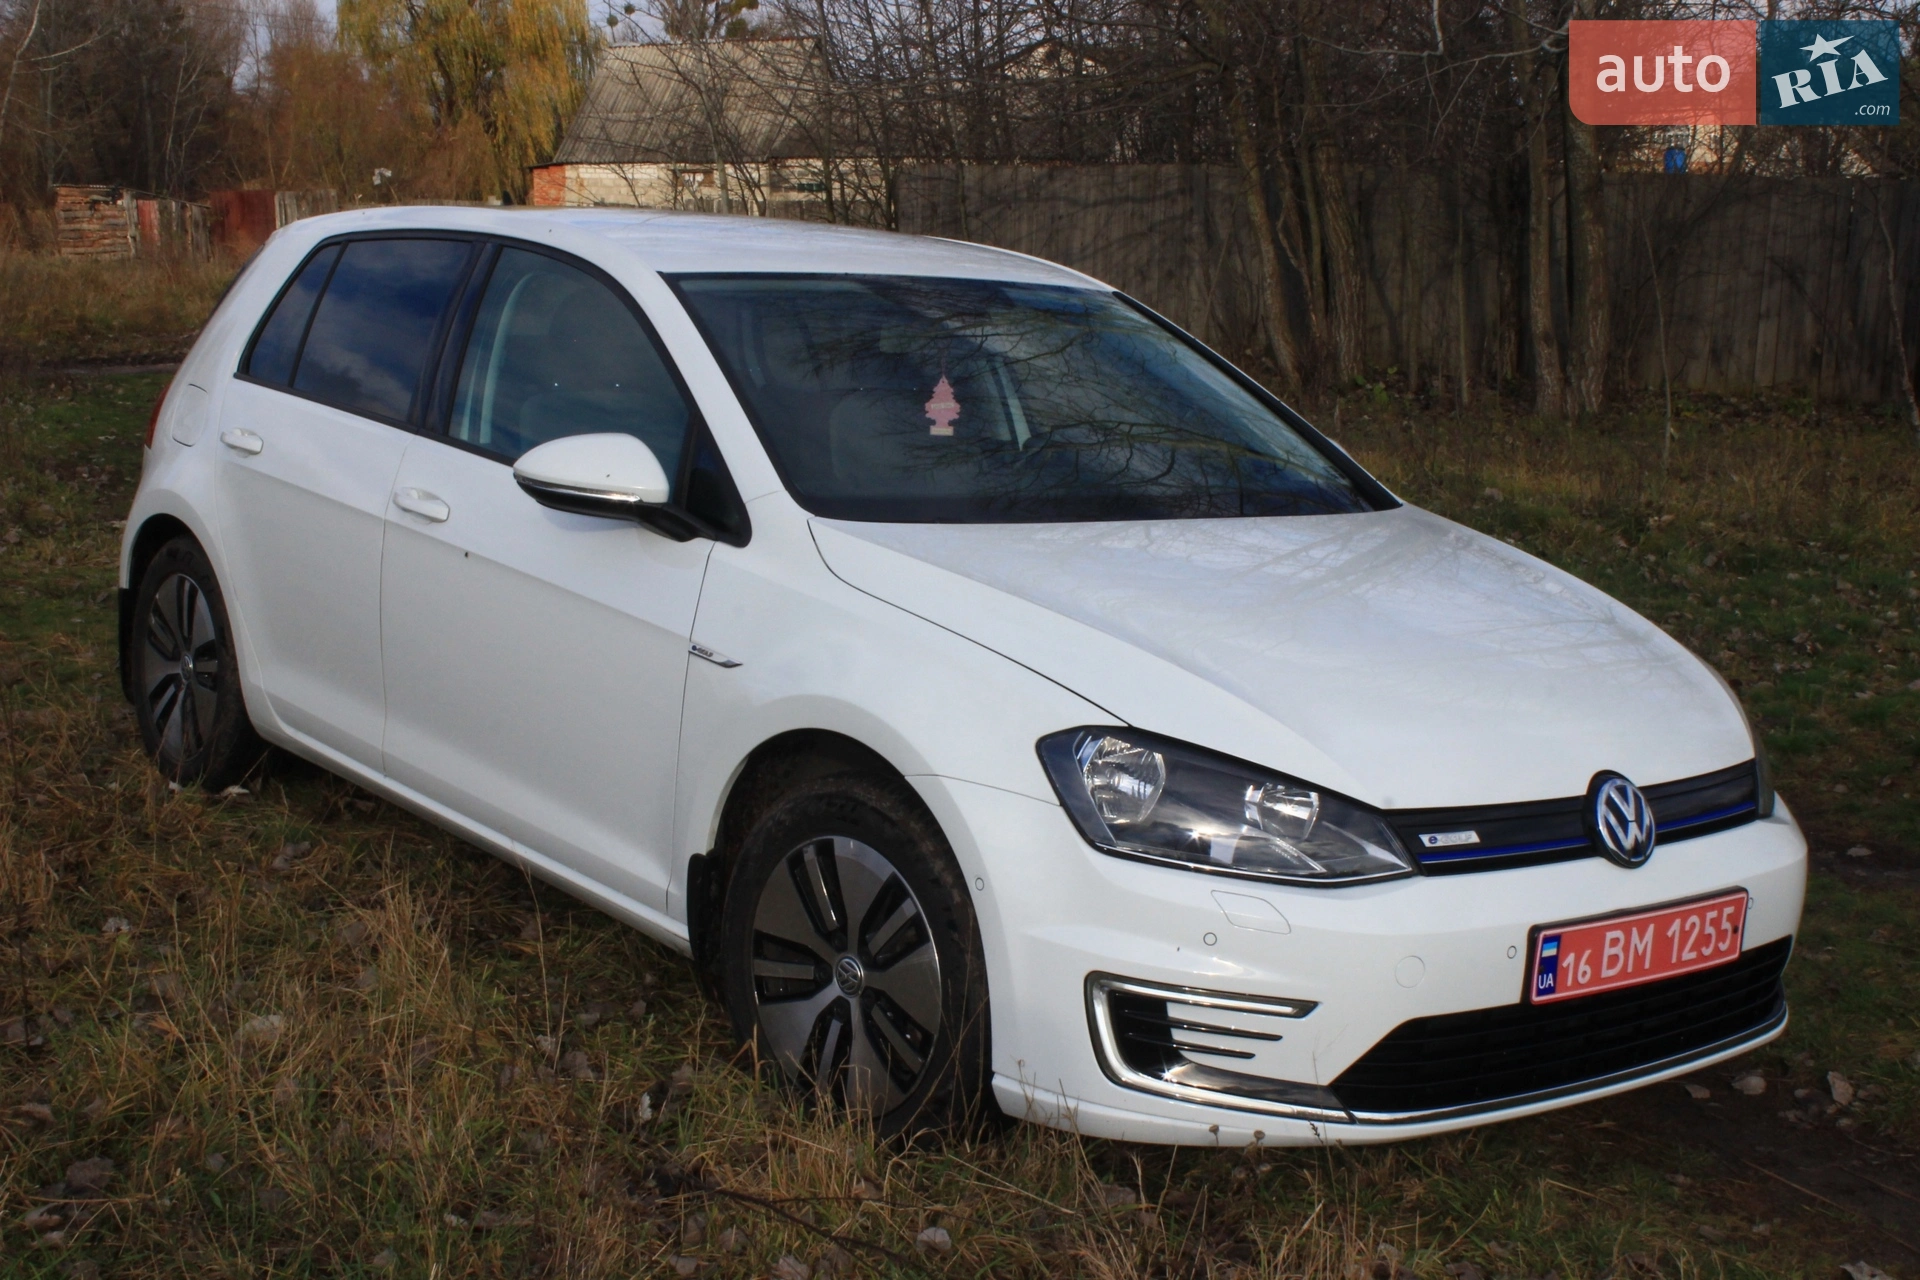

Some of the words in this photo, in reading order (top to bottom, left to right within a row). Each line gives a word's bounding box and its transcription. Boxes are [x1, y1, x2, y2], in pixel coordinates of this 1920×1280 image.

[1561, 949, 1592, 987] 16
[1600, 923, 1655, 979] BM
[1666, 905, 1736, 964] 1255
[1538, 973, 1554, 989] UA
